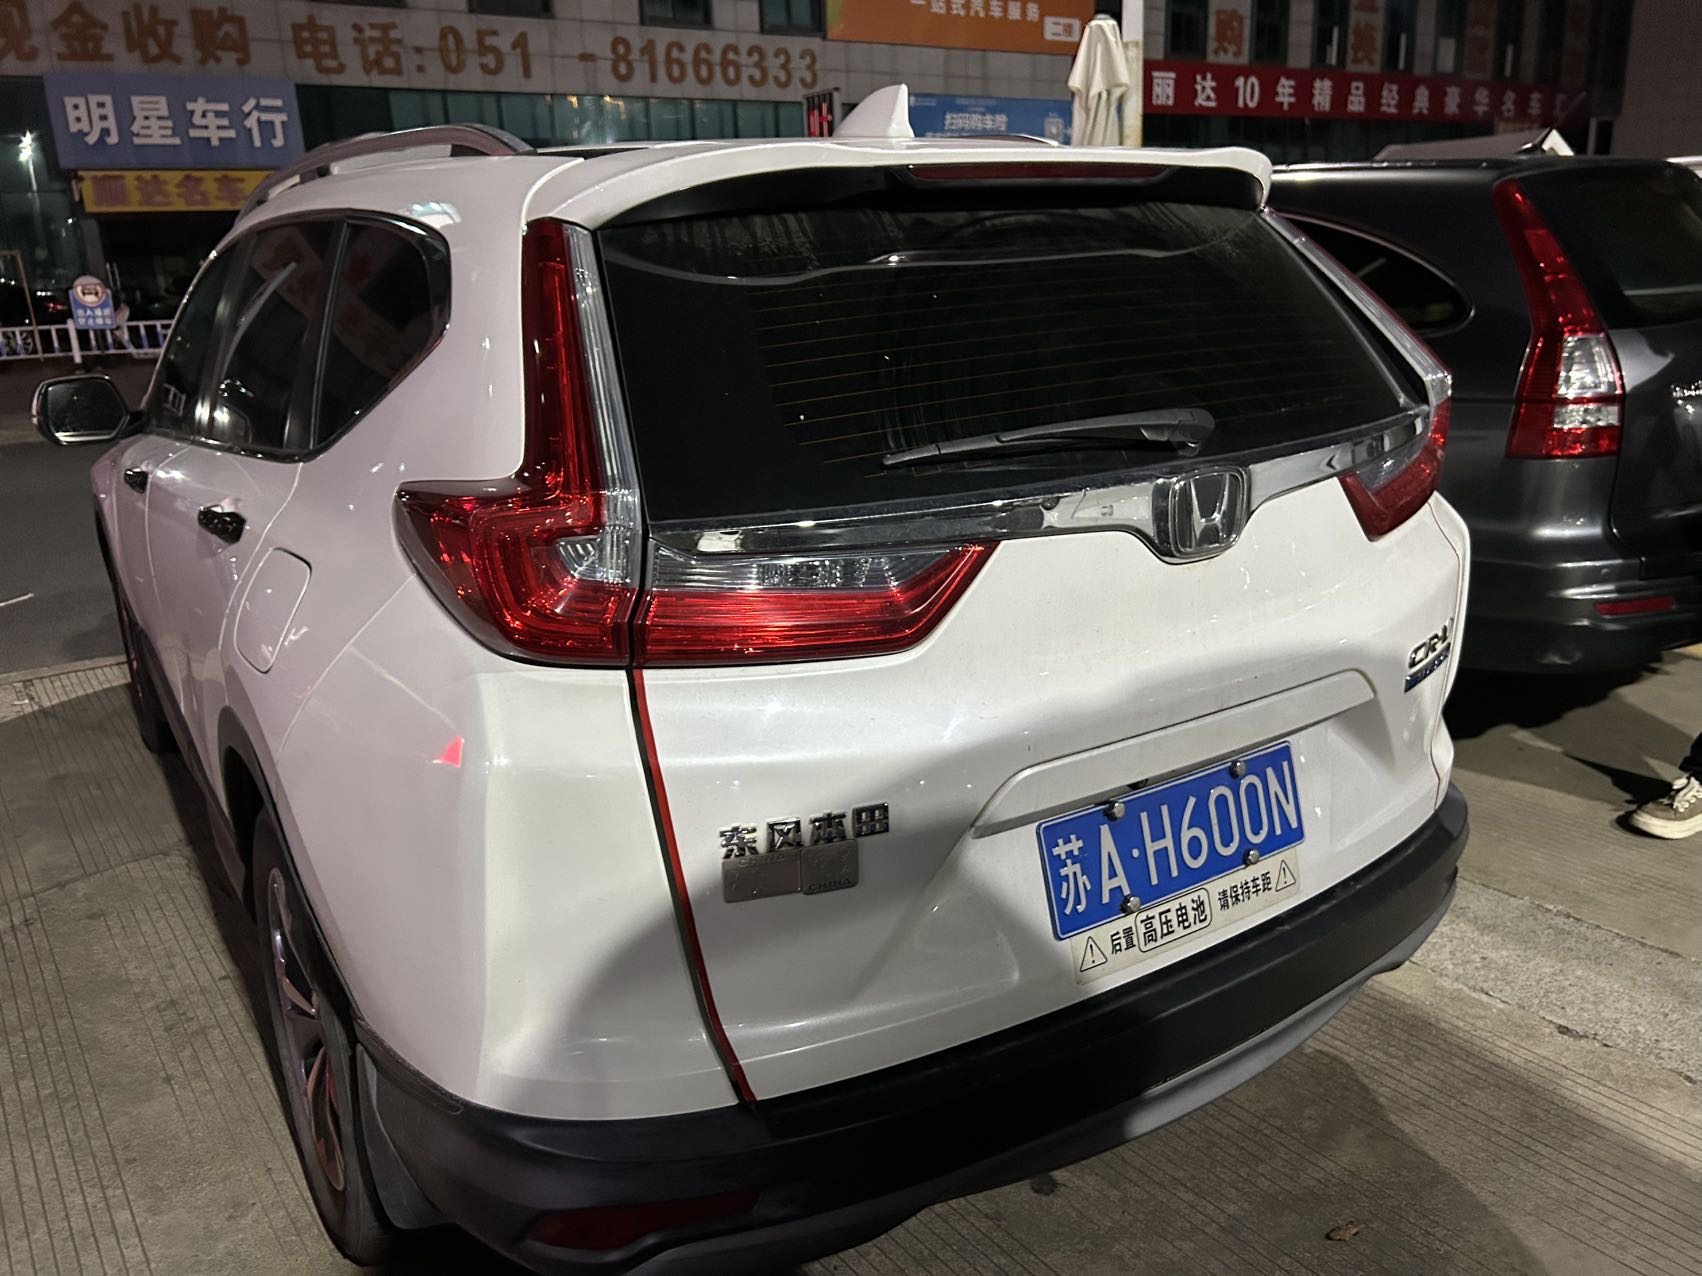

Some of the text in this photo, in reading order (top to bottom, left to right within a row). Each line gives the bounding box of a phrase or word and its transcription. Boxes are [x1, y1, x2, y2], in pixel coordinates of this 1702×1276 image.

[64, 94, 288, 148] 明星车行
[1052, 760, 1298, 916] 苏A·H600N
[1217, 872, 1272, 912] 请保持车距
